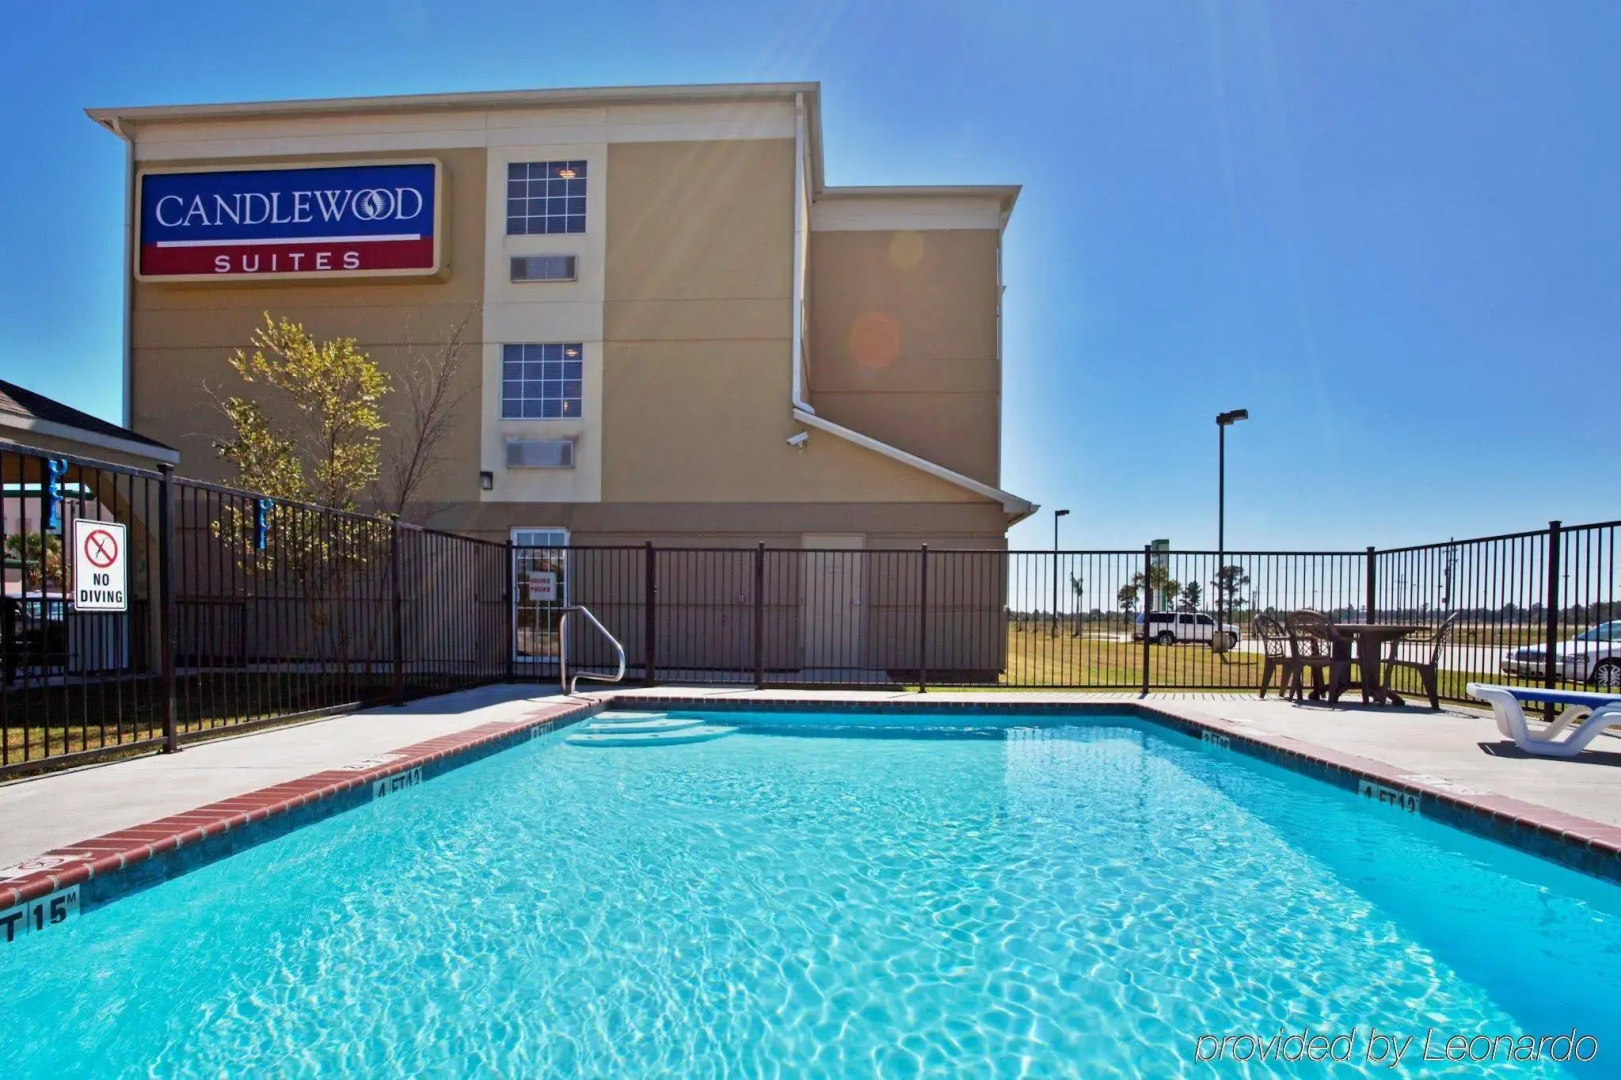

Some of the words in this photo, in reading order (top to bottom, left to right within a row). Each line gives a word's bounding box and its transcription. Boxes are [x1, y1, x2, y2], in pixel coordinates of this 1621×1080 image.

[155, 187, 423, 227] CANDLEWOOD
[214, 251, 361, 273] SUITES
[93, 573, 110, 586] NO
[80, 589, 123, 603] DIVING
